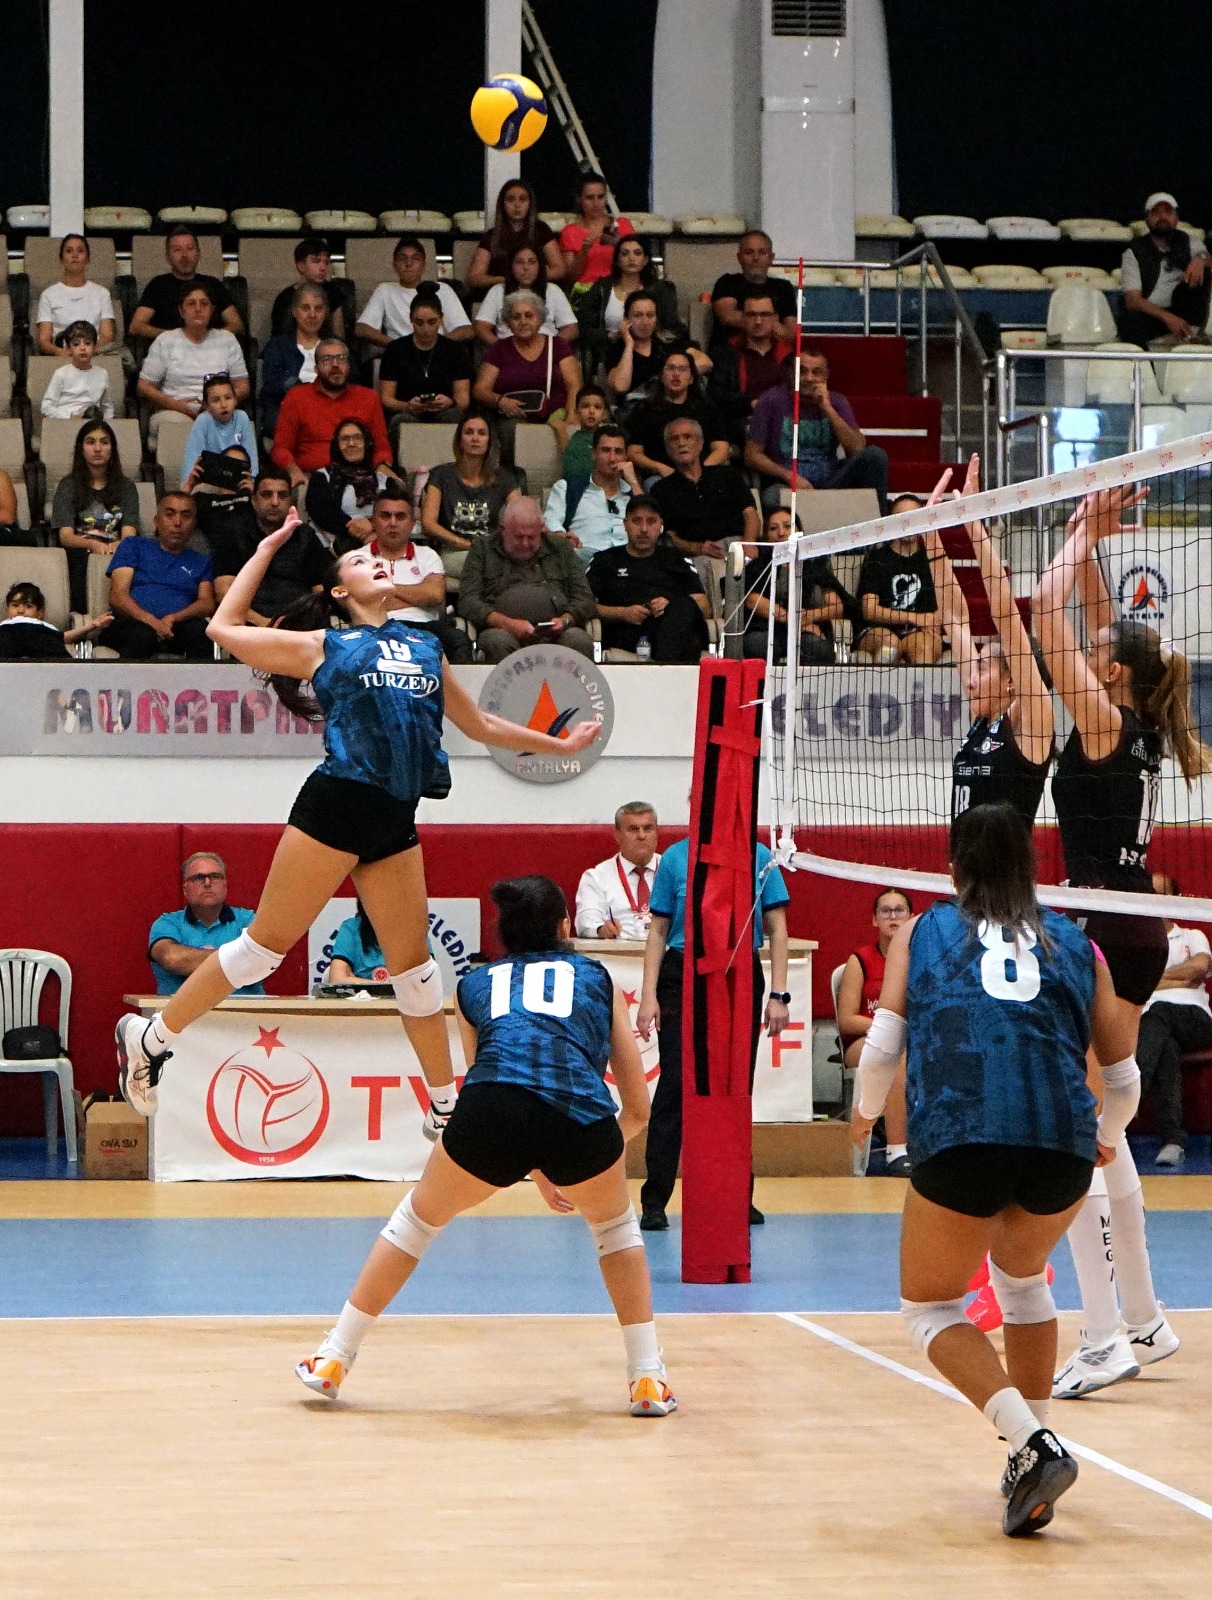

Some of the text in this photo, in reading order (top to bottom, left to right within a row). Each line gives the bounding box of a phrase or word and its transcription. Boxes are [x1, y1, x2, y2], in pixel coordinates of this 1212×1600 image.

[376, 639, 412, 661] 19
[359, 671, 435, 695] TURZEM
[44, 688, 326, 735] MURATPA
[978, 917, 1041, 1003] 8
[487, 960, 576, 1021] 10
